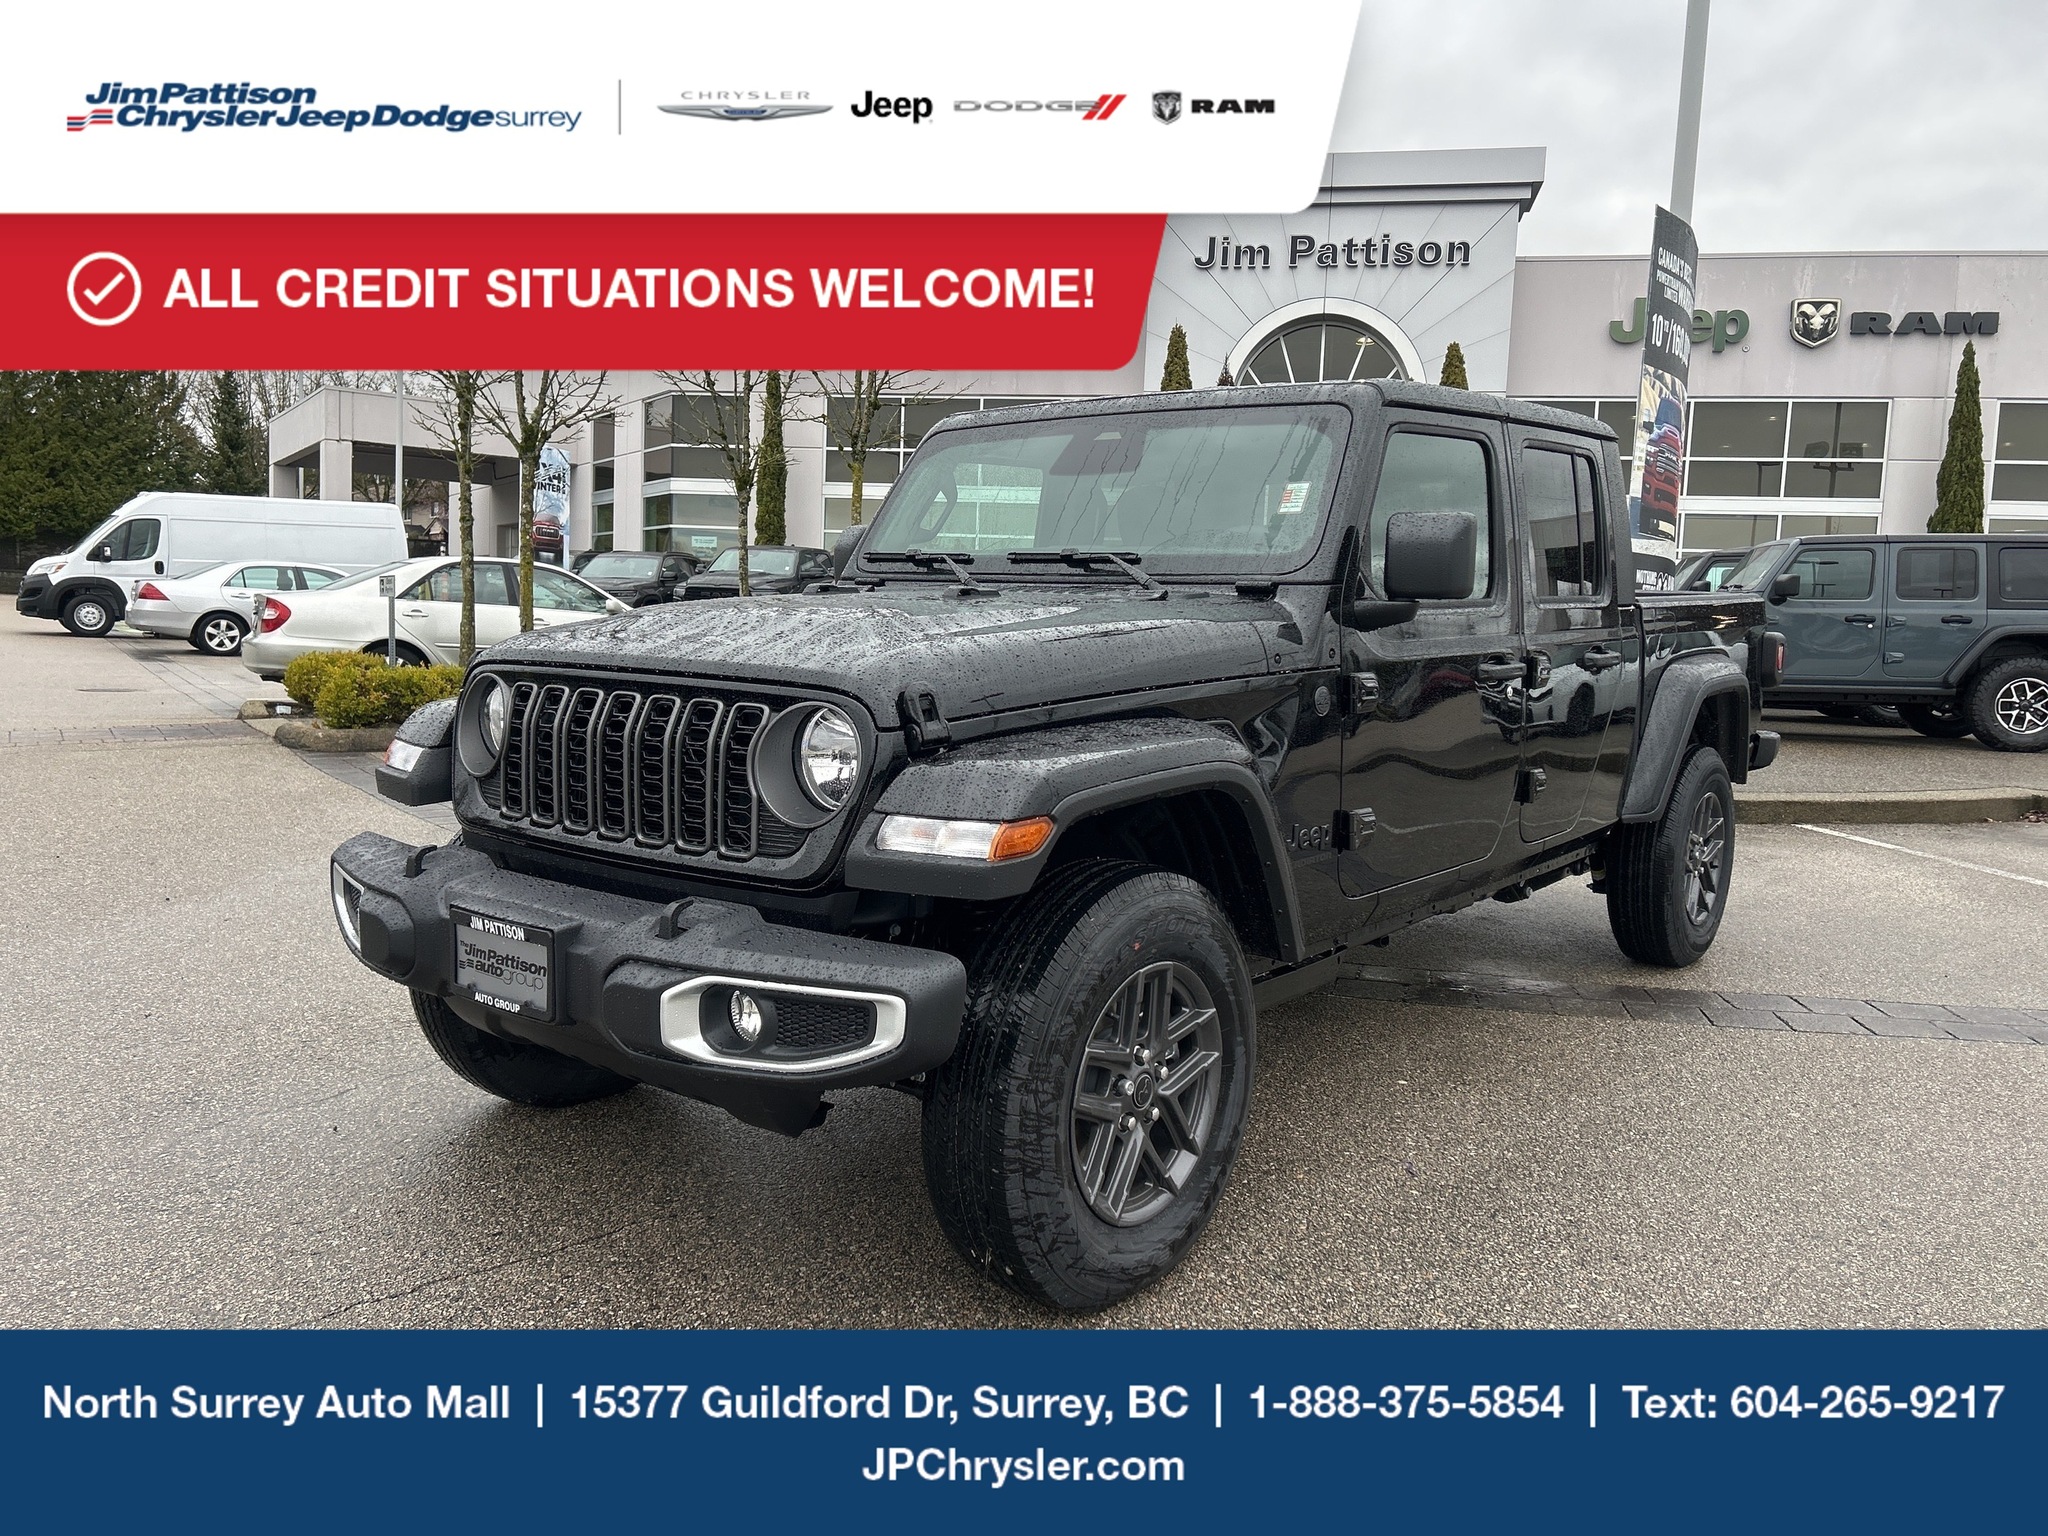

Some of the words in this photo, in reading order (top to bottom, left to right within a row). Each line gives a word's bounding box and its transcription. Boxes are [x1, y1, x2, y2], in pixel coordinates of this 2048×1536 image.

[1194, 236, 1271, 269] Jim
[1288, 232, 1472, 269] Pattison
[1608, 296, 1750, 354] Jep
[1849, 311, 2000, 335] RAM
[536, 481, 561, 494] INTER
[470, 915, 484, 931] JIM
[484, 919, 525, 941] PATTISON
[474, 991, 494, 1006] AUTO
[494, 998, 521, 1014] GROUP
